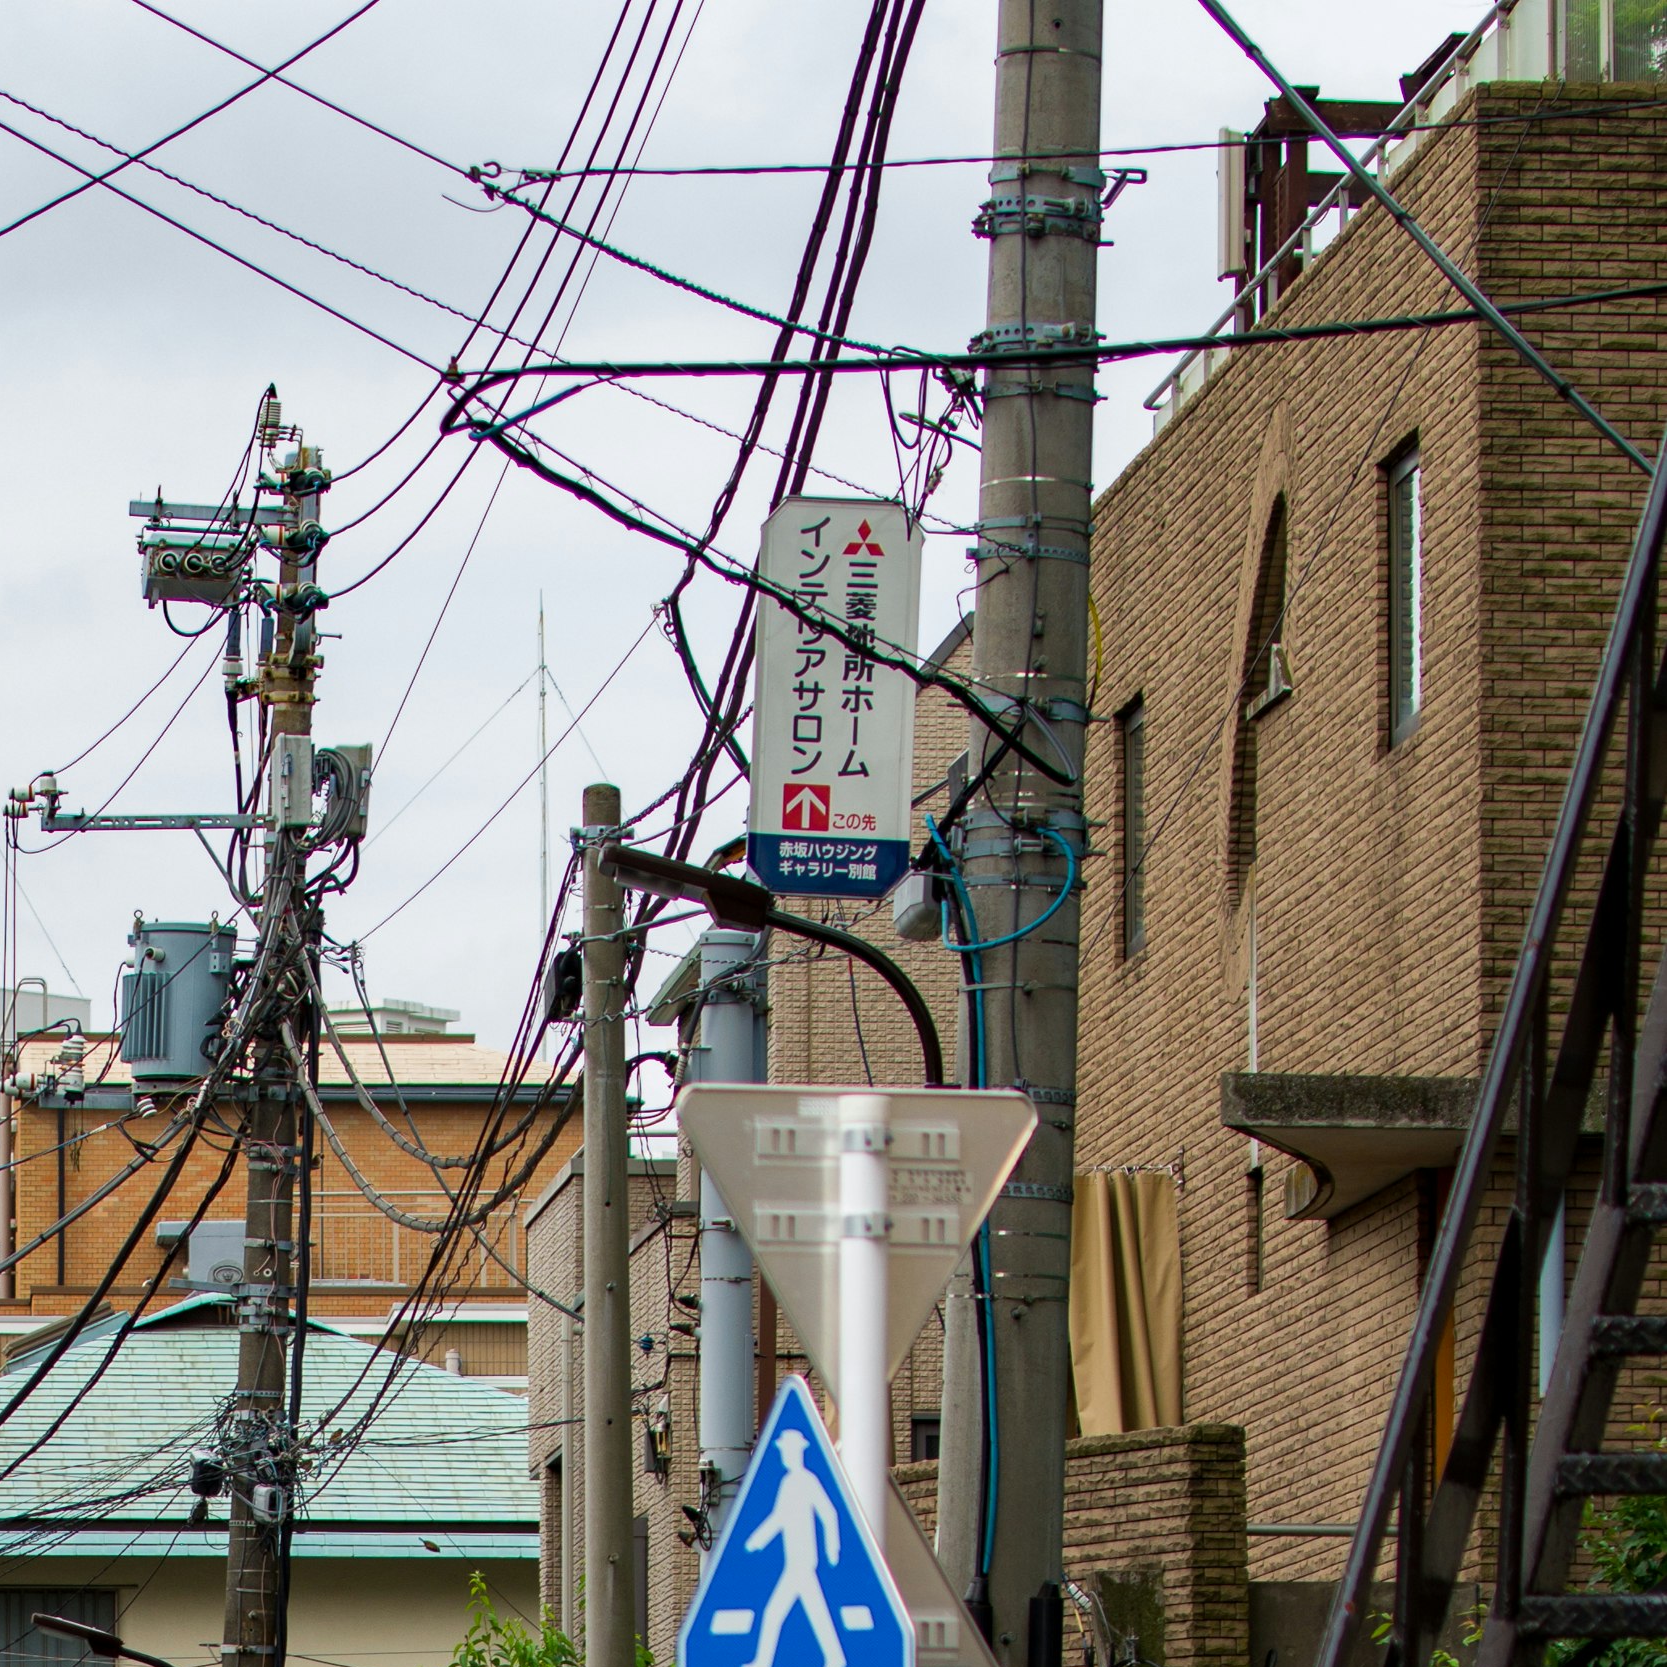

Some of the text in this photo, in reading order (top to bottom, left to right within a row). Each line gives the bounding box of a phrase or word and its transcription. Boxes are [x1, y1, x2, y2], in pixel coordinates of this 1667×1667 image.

[791, 516, 831, 775] インテリアサロン
[837, 561, 879, 778] 三菱地所ホーム
[832, 813, 877, 831] この先
[779, 841, 878, 861] 赤坂ハウジング
[778, 860, 877, 880] ギャラリー別館
